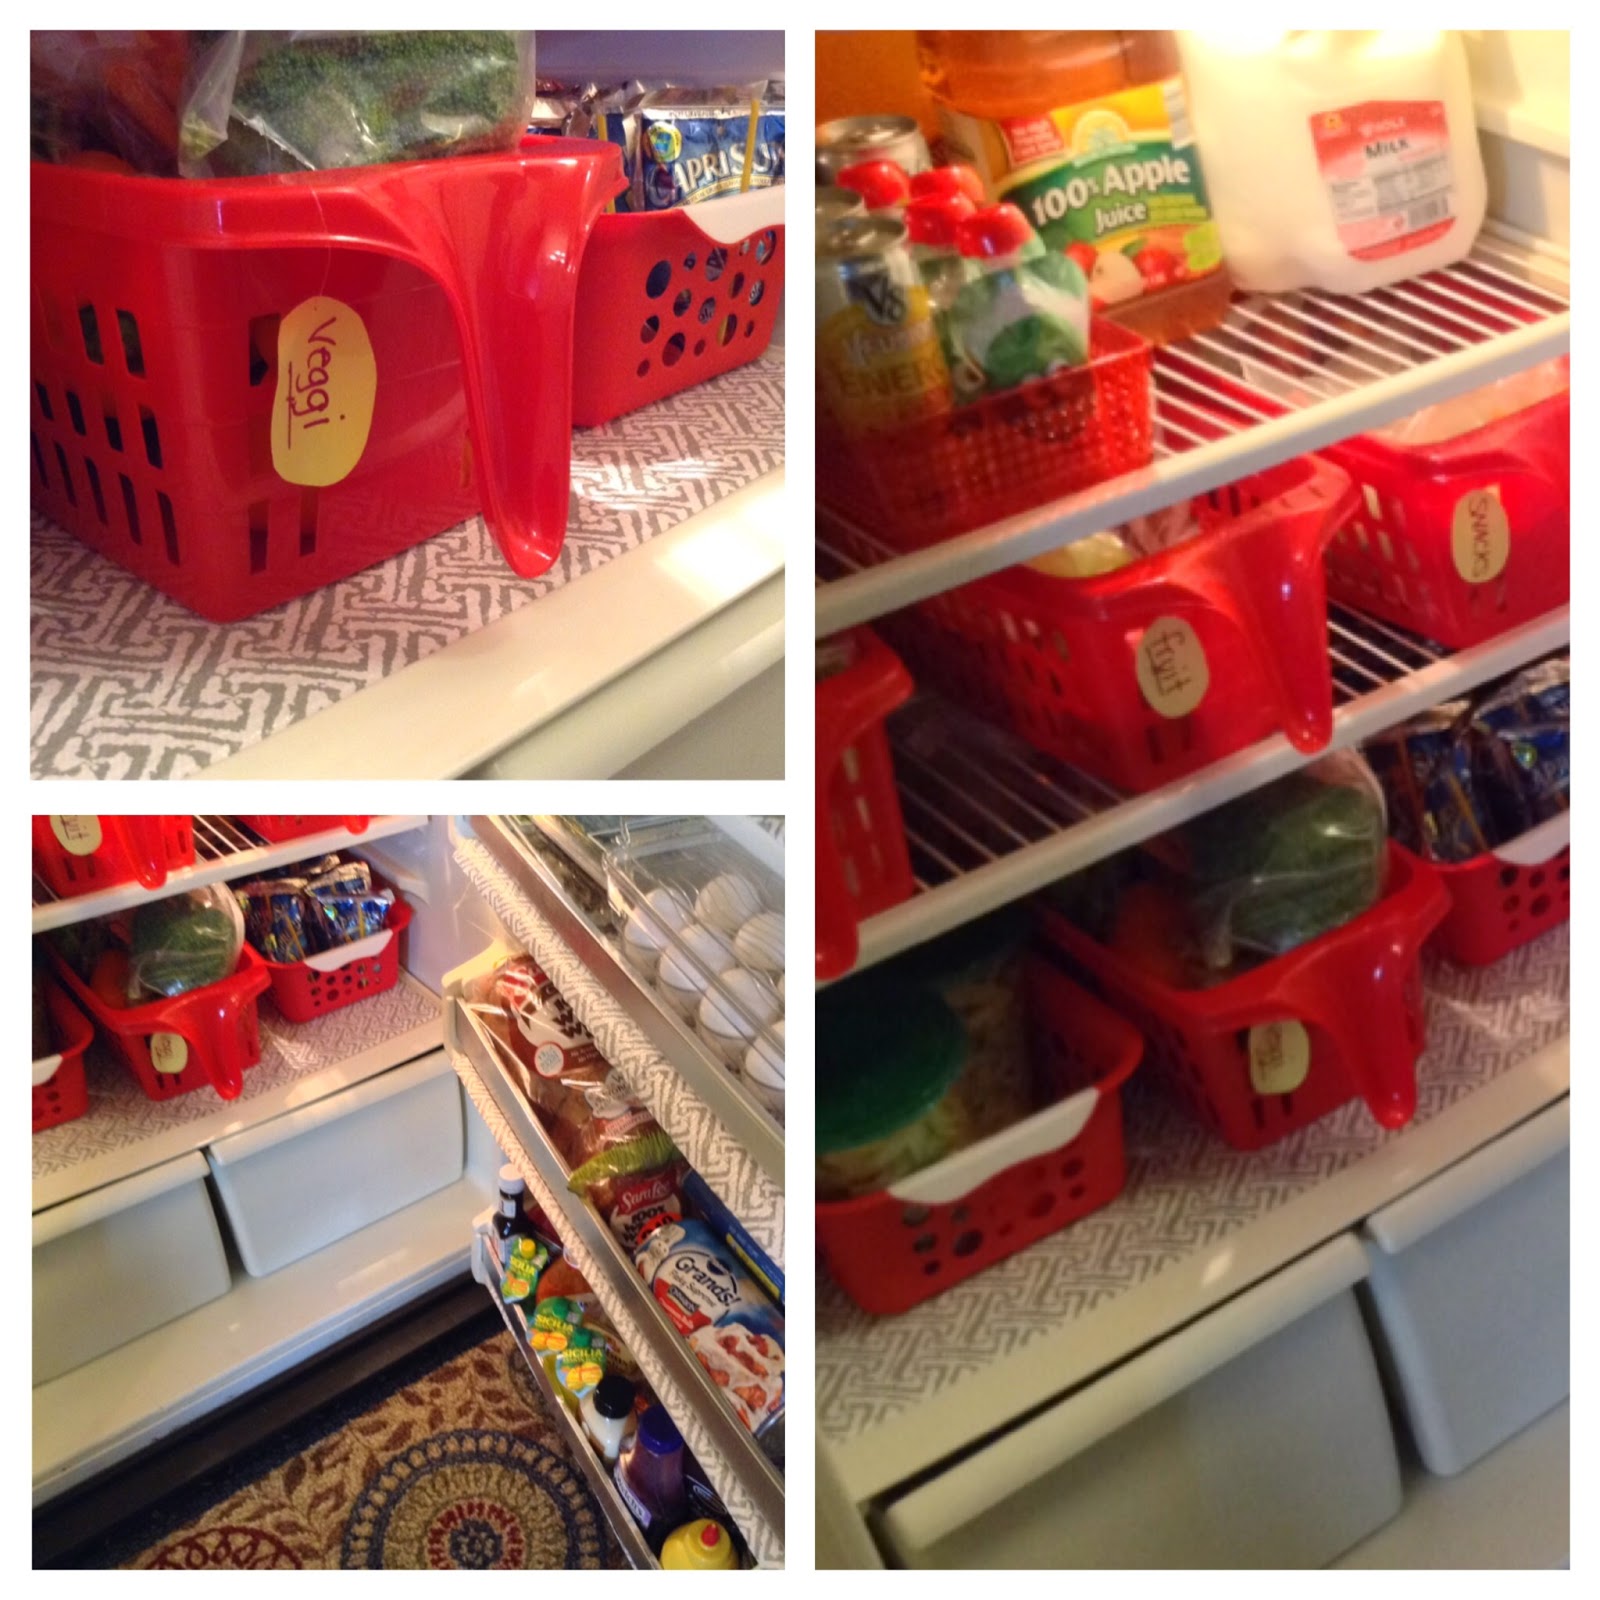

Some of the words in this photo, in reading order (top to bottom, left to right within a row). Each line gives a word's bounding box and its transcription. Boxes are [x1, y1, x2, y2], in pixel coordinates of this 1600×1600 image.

[1103, 154, 1191, 196] Apple
[1095, 202, 1147, 234] Juice
[675, 1256, 742, 1307] Grands!
